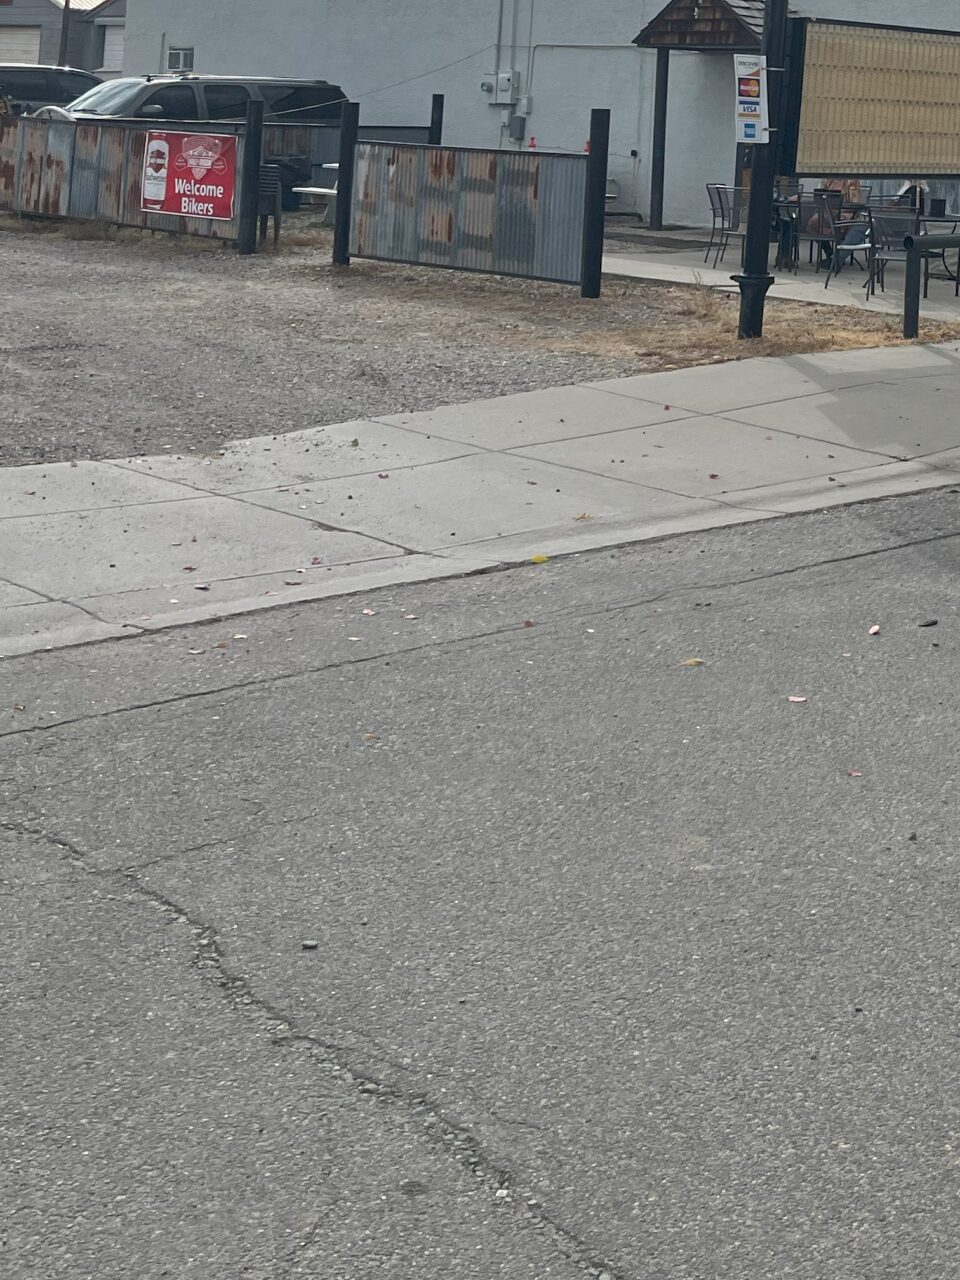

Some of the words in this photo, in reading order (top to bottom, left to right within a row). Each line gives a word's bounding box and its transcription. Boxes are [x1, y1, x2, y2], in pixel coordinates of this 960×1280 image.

[743, 105, 757, 113] VISA
[174, 178, 224, 198] Welcome
[181, 197, 214, 216] Bikers
